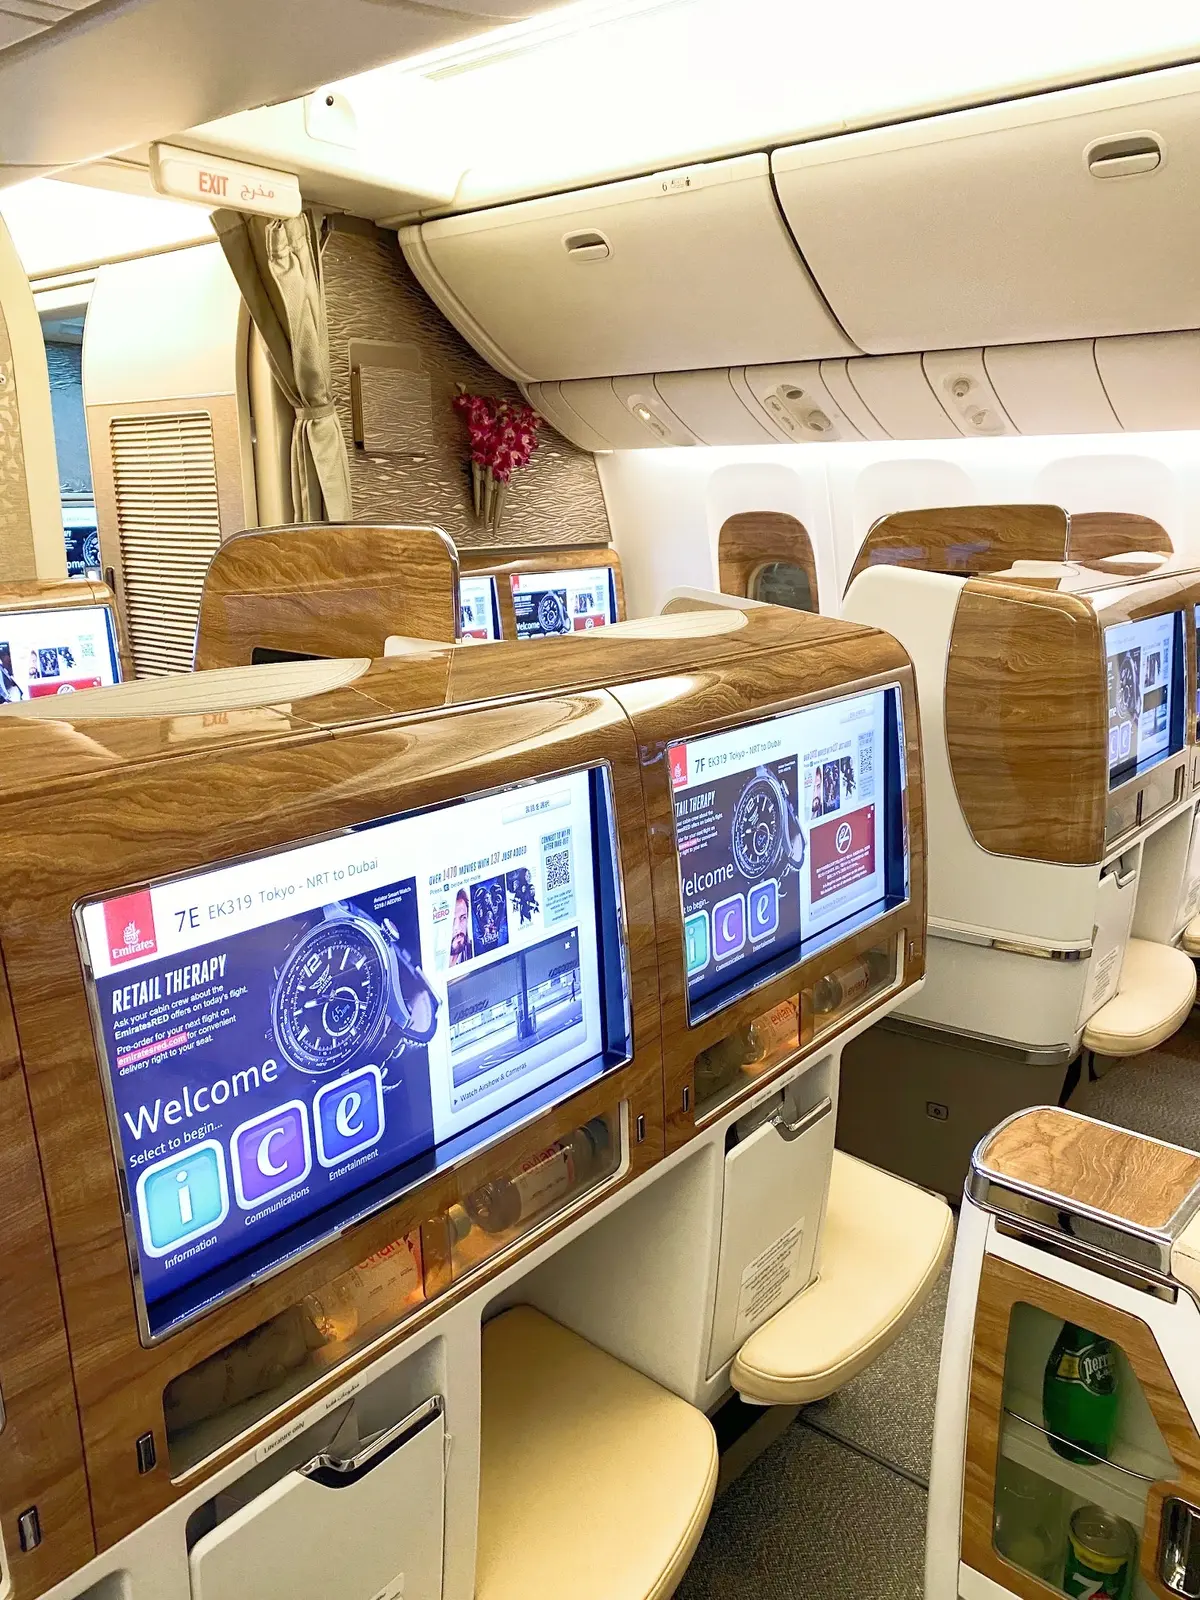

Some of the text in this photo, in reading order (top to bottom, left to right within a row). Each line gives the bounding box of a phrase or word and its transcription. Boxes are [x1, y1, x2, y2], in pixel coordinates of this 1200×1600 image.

[199, 171, 229, 196] EXIT
[240, 185, 275, 200] مخرج
[695, 758, 705, 773] 7F
[708, 753, 727, 767] EK319
[675, 790, 715, 817] TAIL THERAPY
[429, 873, 442, 885] OVER
[459, 861, 477, 875] MOVIES
[501, 849, 512, 861] JUST
[513, 845, 527, 857] ADDED
[174, 906, 201, 933] 7E
[208, 894, 252, 920] EK319
[258, 883, 295, 904] Tokyo
[306, 872, 330, 889] NRT
[333, 869, 345, 881] to
[347, 857, 378, 877] Dubai
[433, 908, 450, 920] HERO
[757, 894, 770, 925] e
[112, 939, 154, 959] Emirates
[112, 954, 226, 1014] RETAIL THERAPY
[113, 985, 224, 1029] Ask your cabin crew about the
[115, 985, 248, 1040] EmiratesRED offers on today's flight.
[771, 1006, 793, 1026] evian
[117, 1008, 230, 1055] Pre-order for your next flight on
[118, 1015, 237, 1066] emiratesred.com for convenient
[119, 1034, 213, 1076] delivery right to your seat.
[123, 1058, 278, 1141] Welcome
[460, 1062, 527, 1102] Watch Airshow & Cameras
[335, 1091, 365, 1137] e
[129, 1122, 223, 1168] Select to begin...
[328, 1148, 379, 1182] Entertainment
[175, 1170, 193, 1225] i
[244, 1185, 310, 1226] Communications
[164, 1234, 217, 1270] Information
[263, 1421, 305, 1454] Literature only
